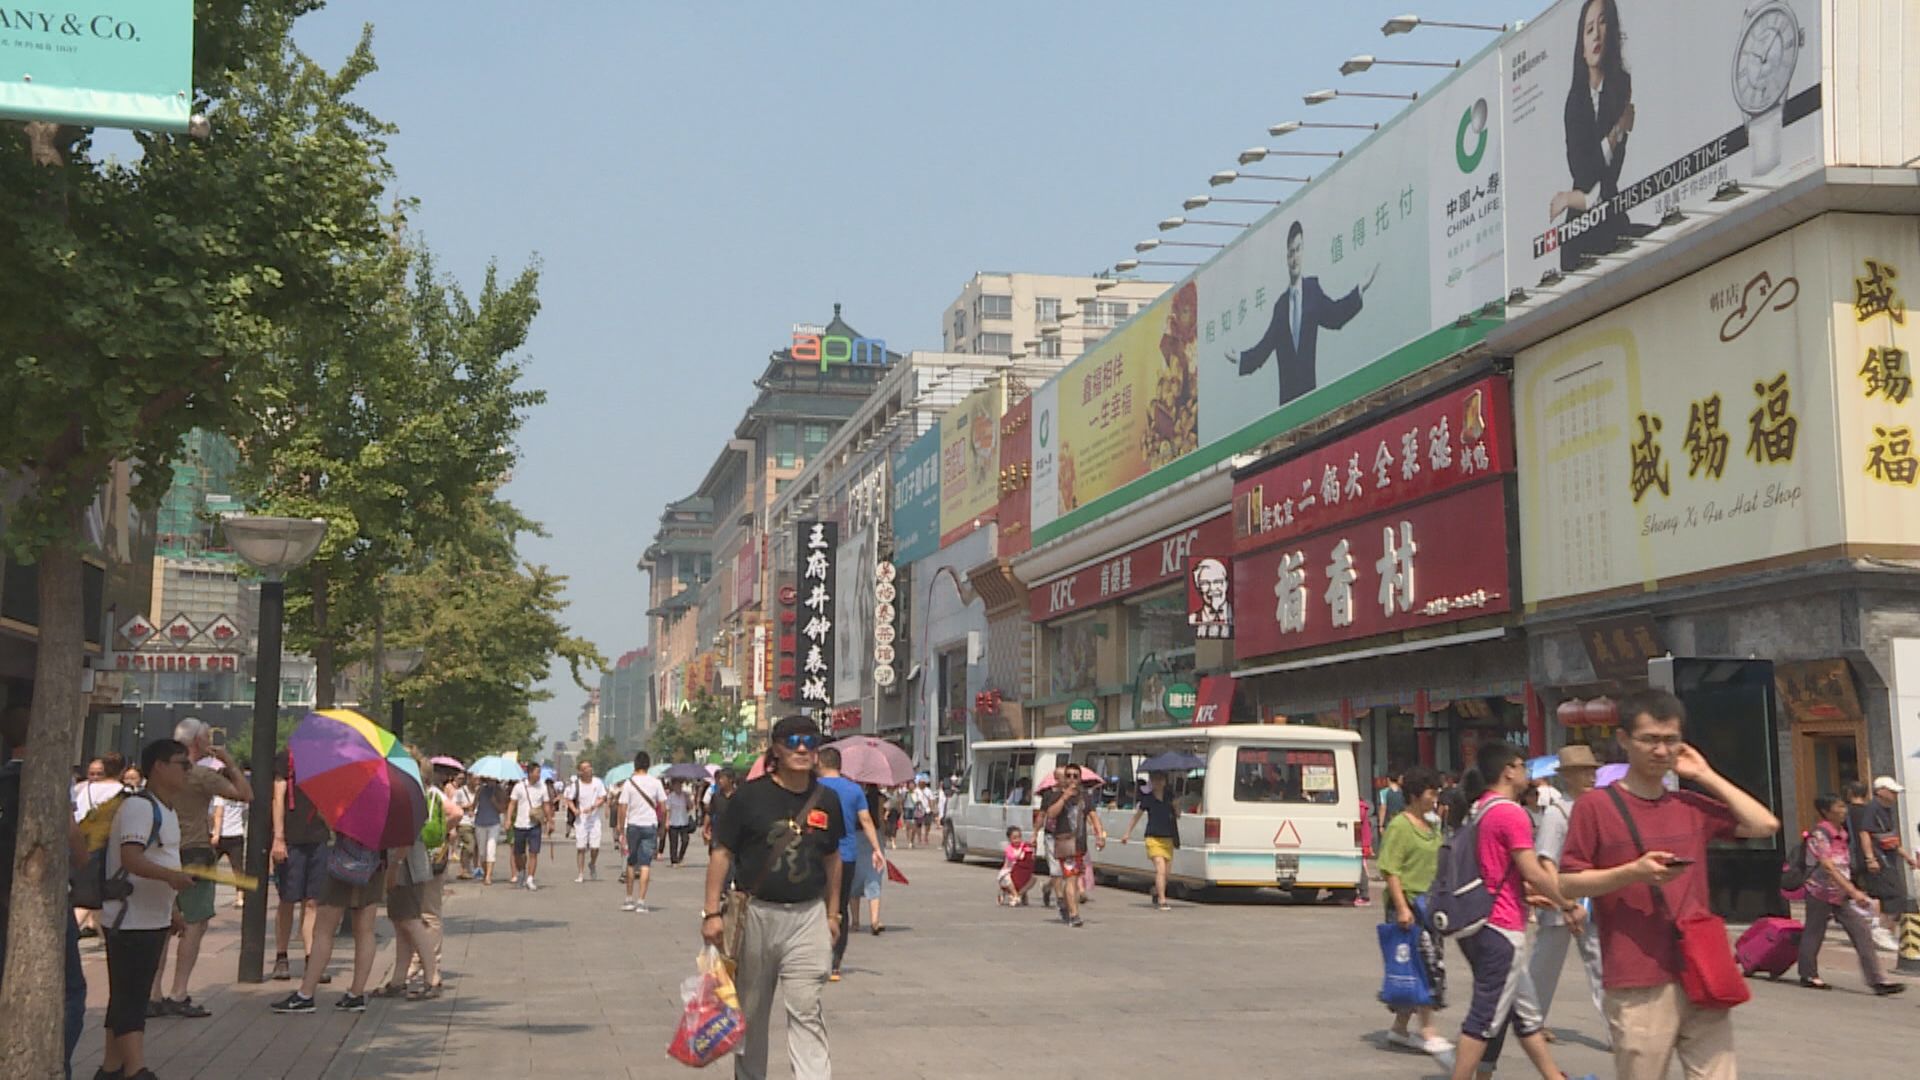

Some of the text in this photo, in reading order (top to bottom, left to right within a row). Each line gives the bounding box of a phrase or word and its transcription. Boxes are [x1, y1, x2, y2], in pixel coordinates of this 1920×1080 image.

[60, 13, 83, 36] &
[1558, 201, 1609, 243] TISSOT
[1612, 188, 1639, 215] THIS
[1640, 179, 1652, 201] IS
[1653, 156, 1691, 192] YOUR
[1693, 137, 1728, 171] TIME
[1331, 184, 1414, 264] 值得托付
[1446, 197, 1500, 238] CHINA LIFE
[791, 335, 888, 373] apm
[1728, 490, 1759, 518] Hat
[1763, 482, 1801, 509] Shop
[1160, 529, 1198, 576] KFC
[1050, 576, 1076, 612] KFC
[1101, 557, 1131, 596] 肯德基
[1275, 521, 1417, 634] 稻香村
[1196, 704, 1217, 724] KFC
